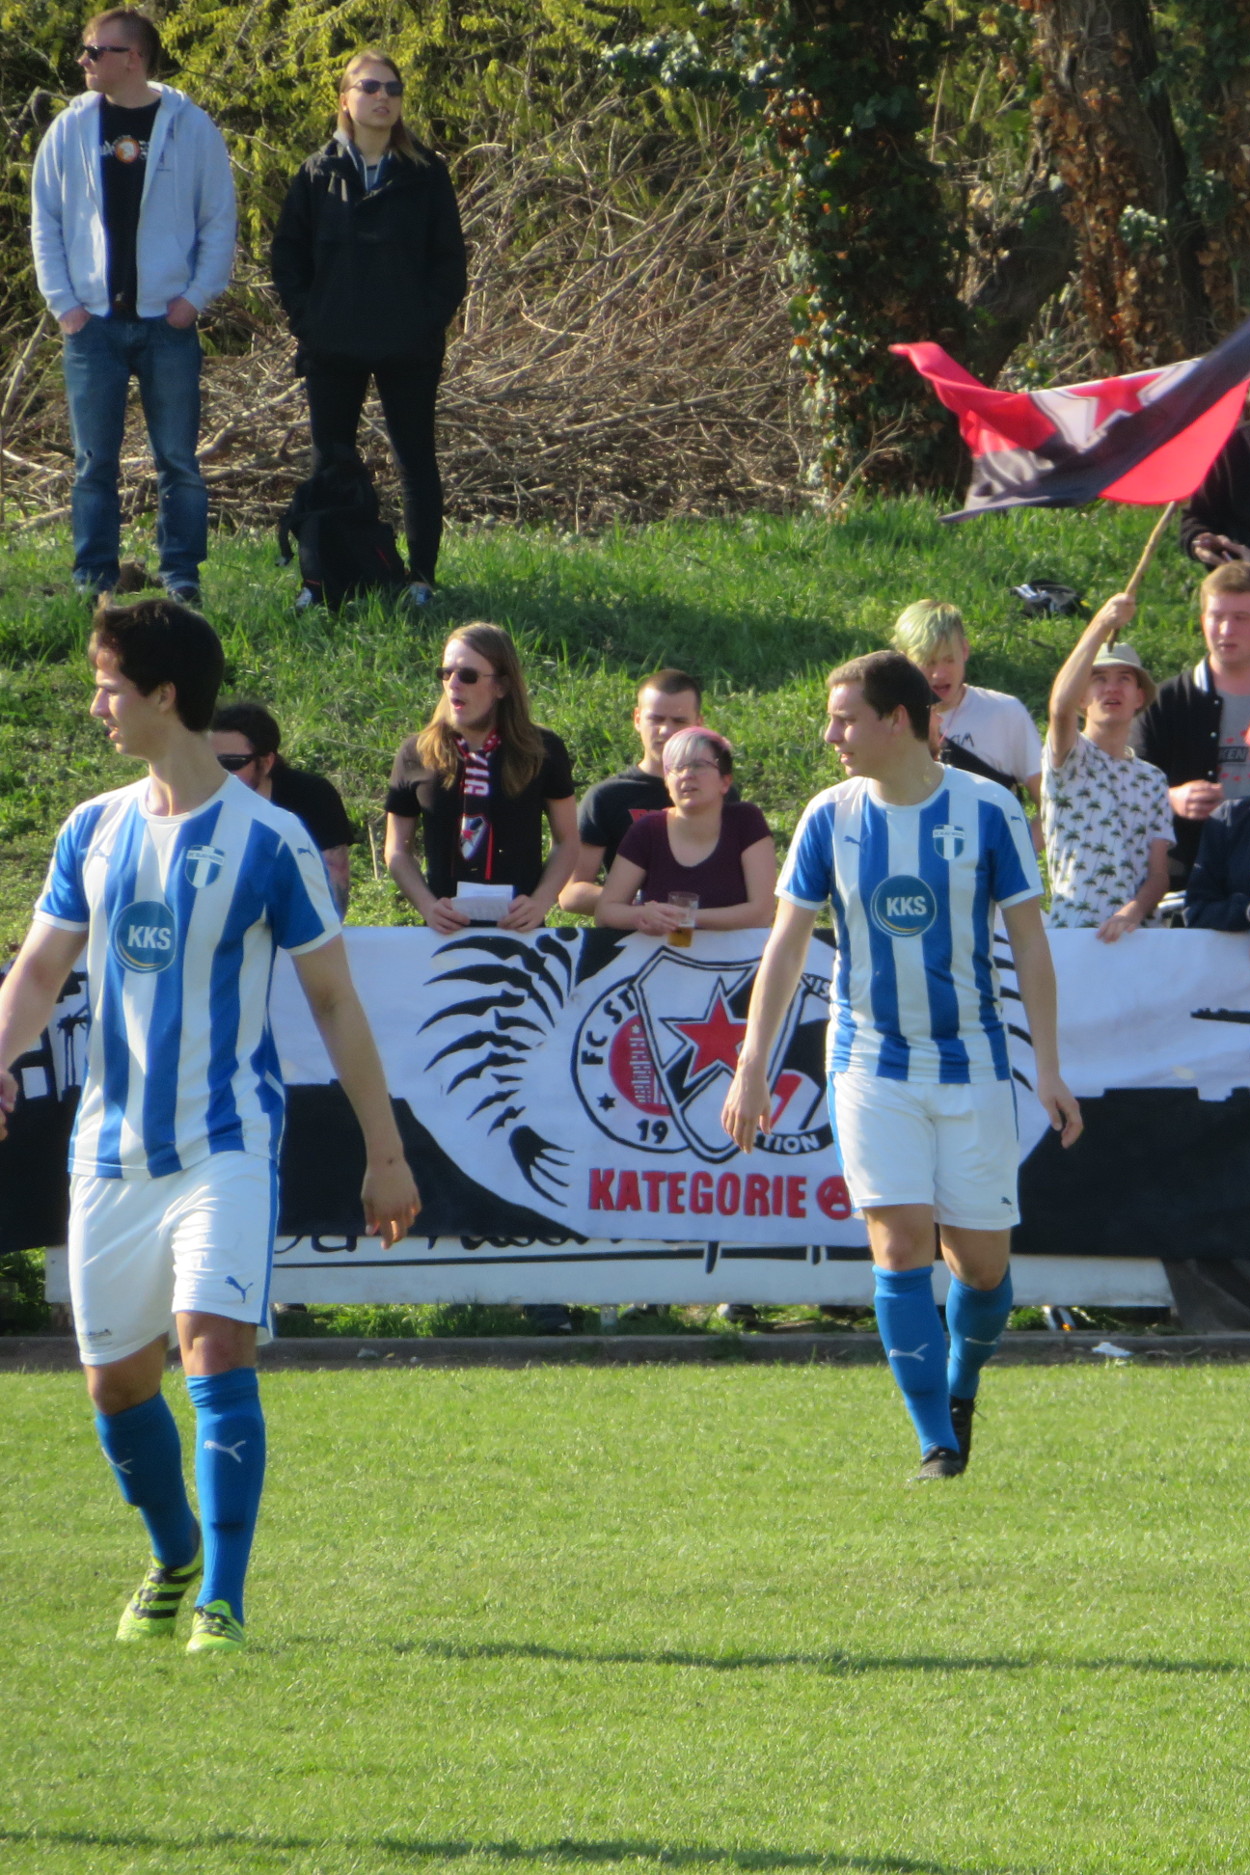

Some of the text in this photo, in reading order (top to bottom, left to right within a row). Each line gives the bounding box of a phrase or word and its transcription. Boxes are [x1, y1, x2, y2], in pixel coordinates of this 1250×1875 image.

[886, 895, 928, 918] KKS
[127, 924, 171, 950] KKS
[581, 1030, 608, 1065] FC
[757, 1133, 820, 1154] TION
[588, 1168, 808, 1218] KATEGORIE
